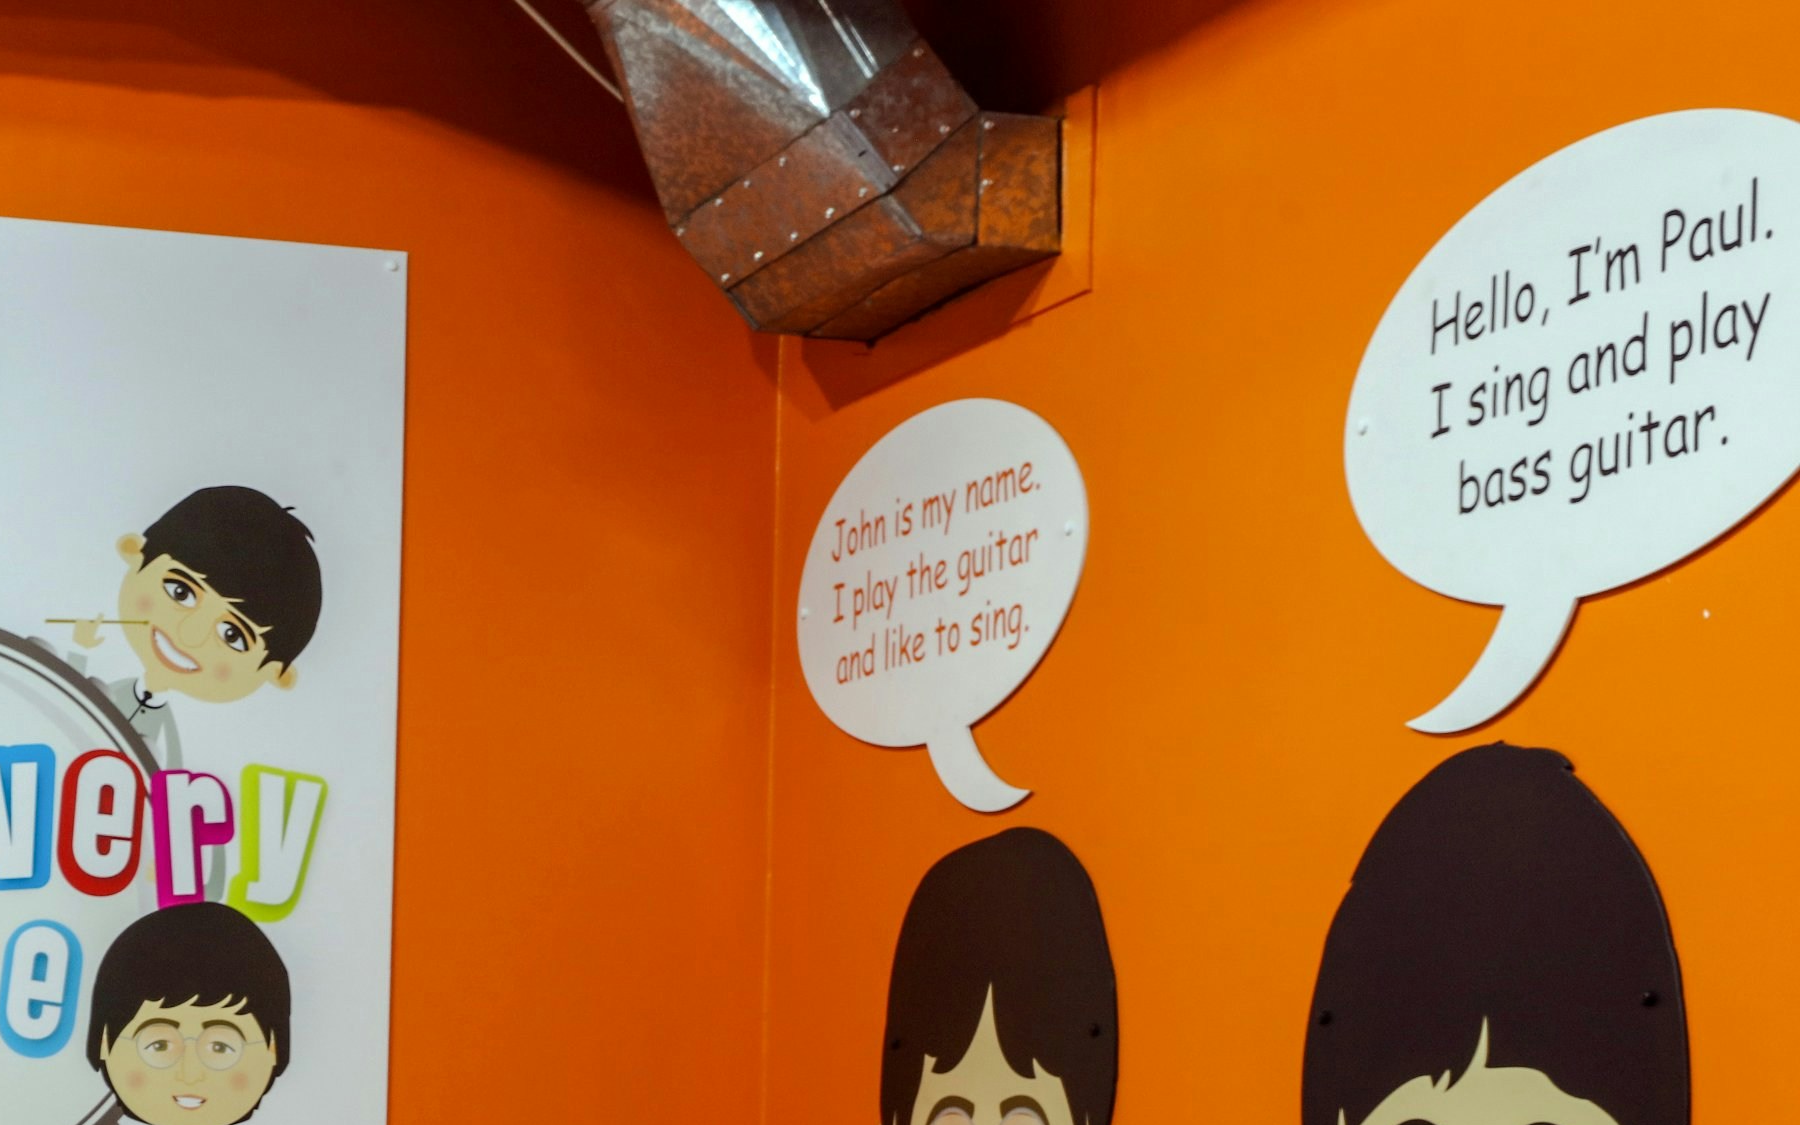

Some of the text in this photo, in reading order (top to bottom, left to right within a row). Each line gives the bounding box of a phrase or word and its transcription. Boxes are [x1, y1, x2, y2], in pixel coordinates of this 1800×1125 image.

[1430, 176, 1774, 355] Hello, I'm Paul.
[1430, 290, 1772, 439] I sing and play
[831, 461, 1042, 563] John is my name.
[1458, 404, 1729, 516] bass guitar.
[832, 528, 1039, 631] I play the guitar
[836, 599, 1031, 685] and like to sing.
